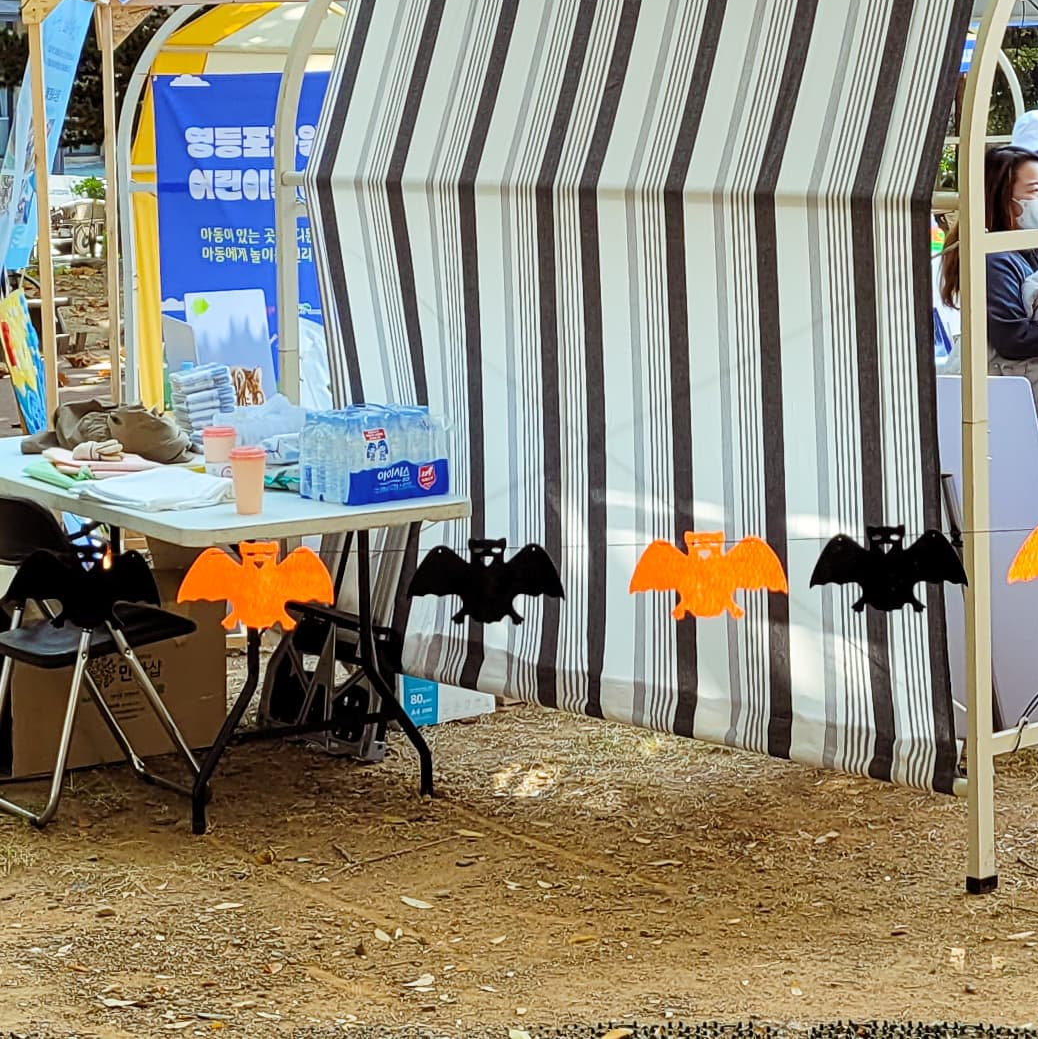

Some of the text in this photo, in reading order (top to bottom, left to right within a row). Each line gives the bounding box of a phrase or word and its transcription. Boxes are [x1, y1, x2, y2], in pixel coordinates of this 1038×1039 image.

[200, 227, 234, 243] 아동이
[236, 228, 260, 244] 있는
[202, 246, 248, 262] 아동에게
[410, 693, 423, 705] 80
